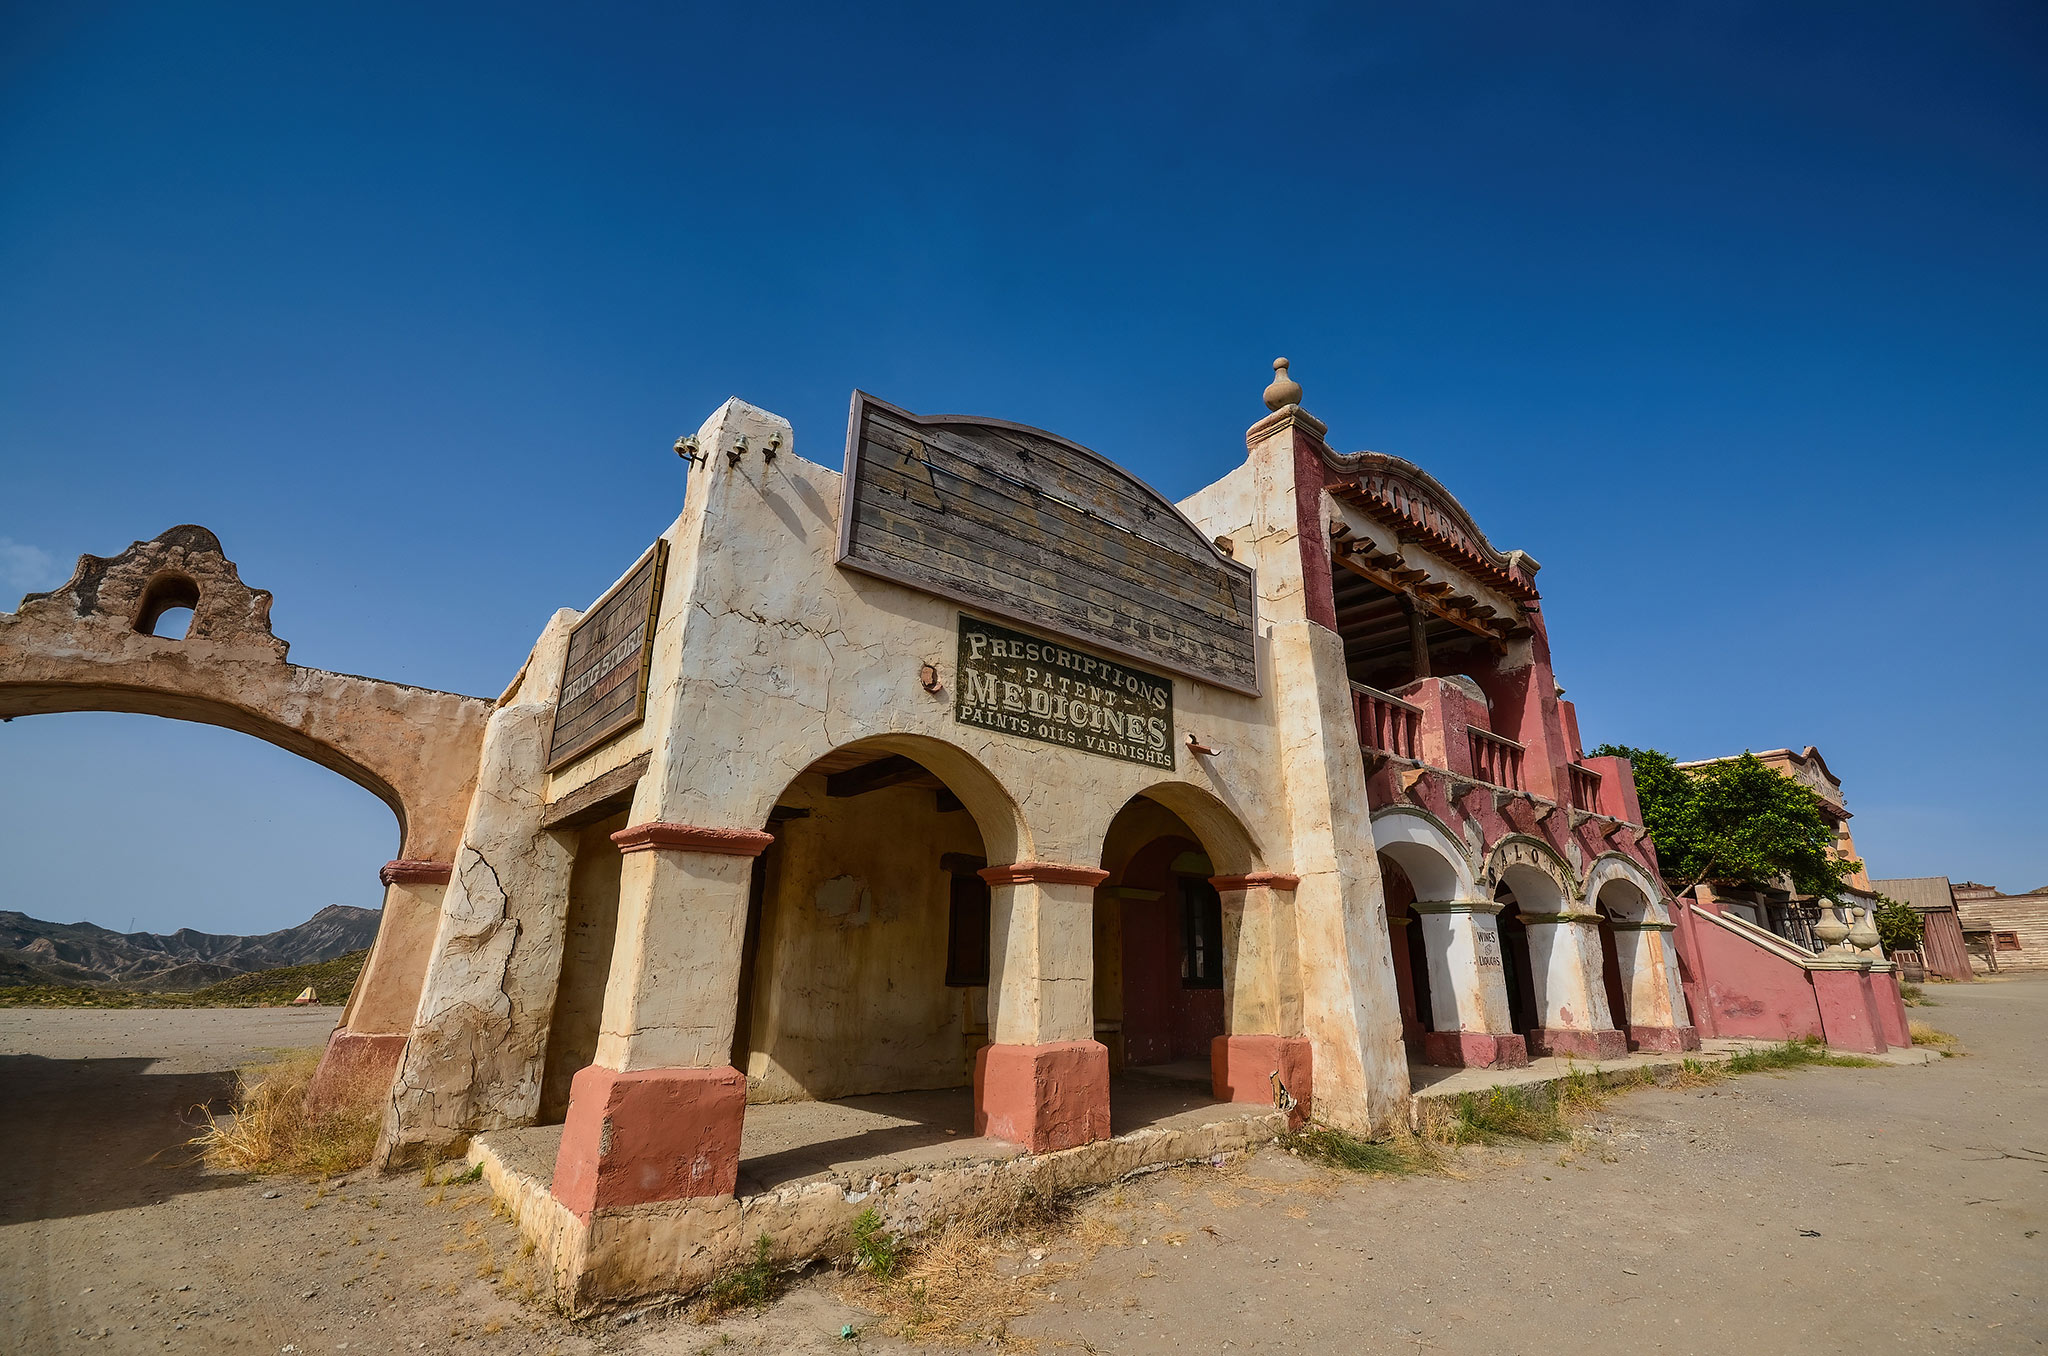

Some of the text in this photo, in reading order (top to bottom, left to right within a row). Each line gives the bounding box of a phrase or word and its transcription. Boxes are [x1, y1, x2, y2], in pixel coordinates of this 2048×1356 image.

[876, 509, 1241, 670] DRUG STORE
[560, 660, 600, 708] DRUG
[600, 624, 644, 678] STORE
[966, 632, 1168, 710] PRESCRIPTIONS
[1025, 667, 1118, 706] PATENT
[960, 705, 1172, 767] PAINTS OILS VARNISHES
[964, 667, 1168, 751] MEDICINES
[1476, 931, 1496, 943] WINES
